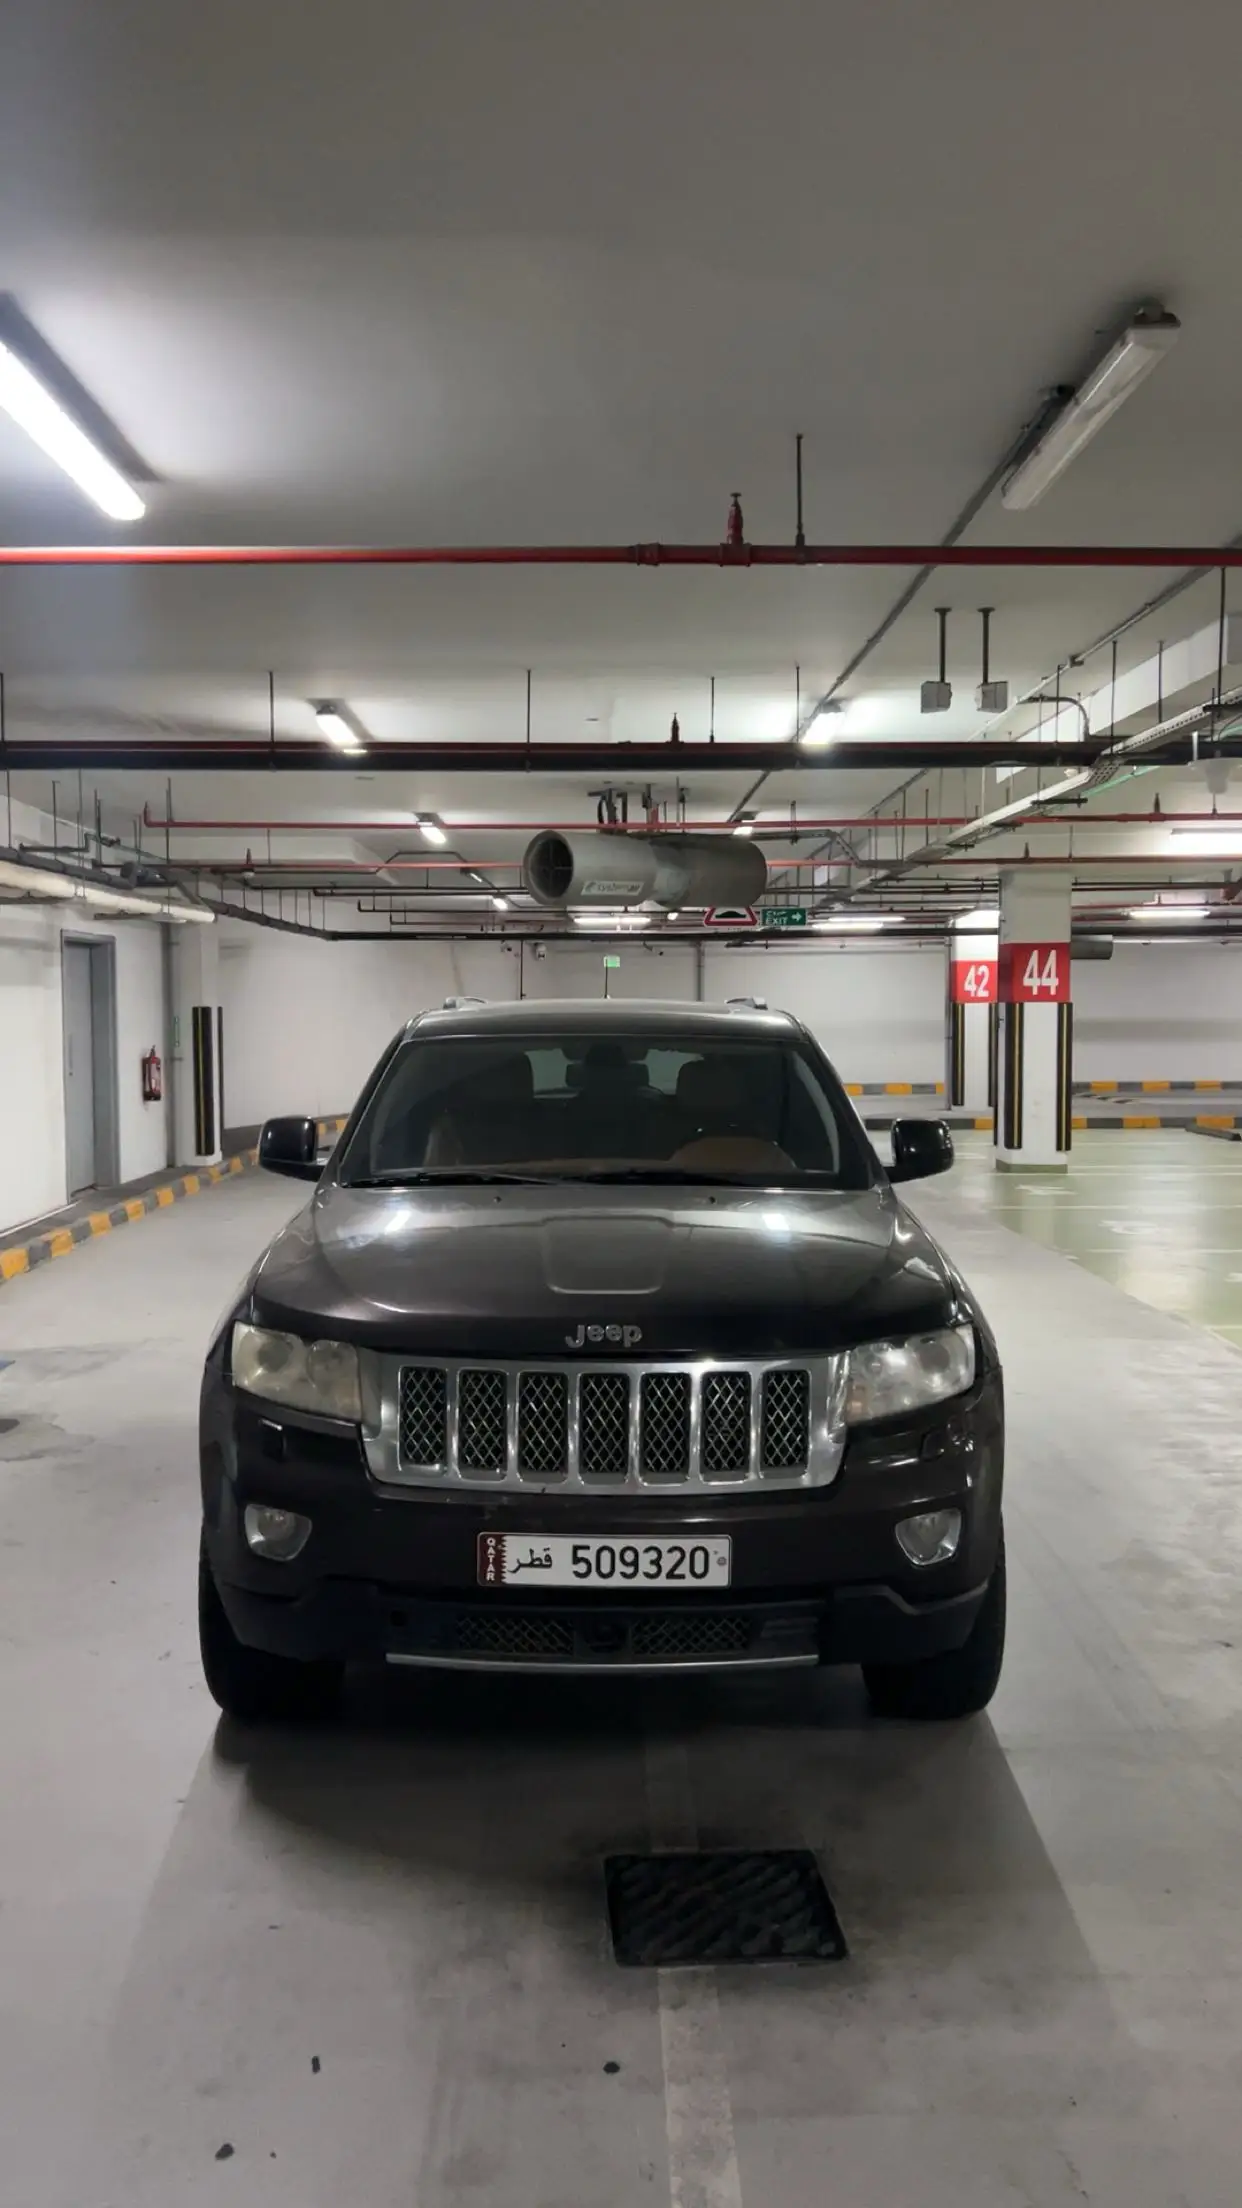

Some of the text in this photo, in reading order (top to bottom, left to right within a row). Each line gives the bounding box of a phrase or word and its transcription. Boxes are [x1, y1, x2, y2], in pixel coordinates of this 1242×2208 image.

[765, 916, 788, 925] EXIT
[963, 964, 990, 998] 42
[1022, 949, 1059, 996] 44
[564, 1324, 642, 1349] Jeep
[486, 1537, 496, 1581] QATAR
[507, 1544, 709, 1580] قطر 509320
